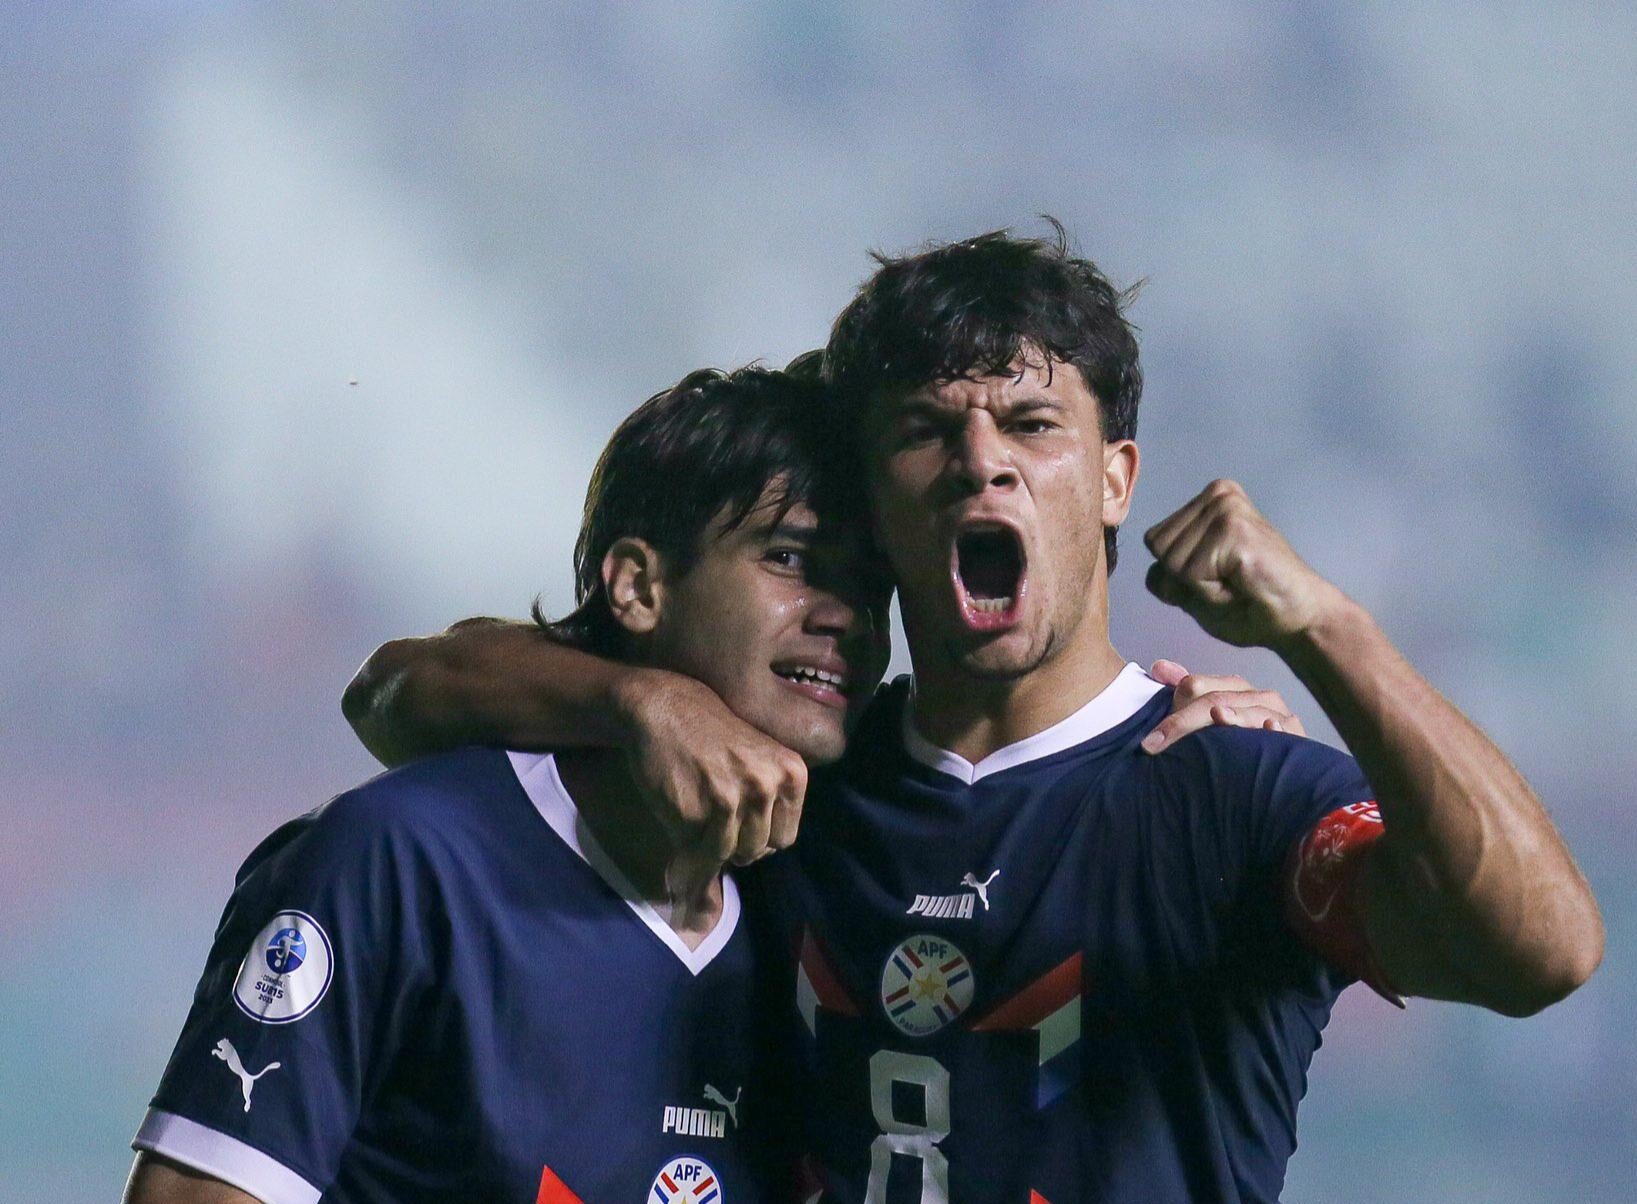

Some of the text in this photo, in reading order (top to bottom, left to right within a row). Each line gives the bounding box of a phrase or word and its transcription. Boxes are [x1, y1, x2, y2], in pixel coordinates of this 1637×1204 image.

[905, 894, 976, 919] PUMA
[917, 940, 948, 959] APF
[255, 981, 284, 999] SUB15
[662, 1105, 726, 1139] PUMA
[673, 1163, 703, 1182] APF
